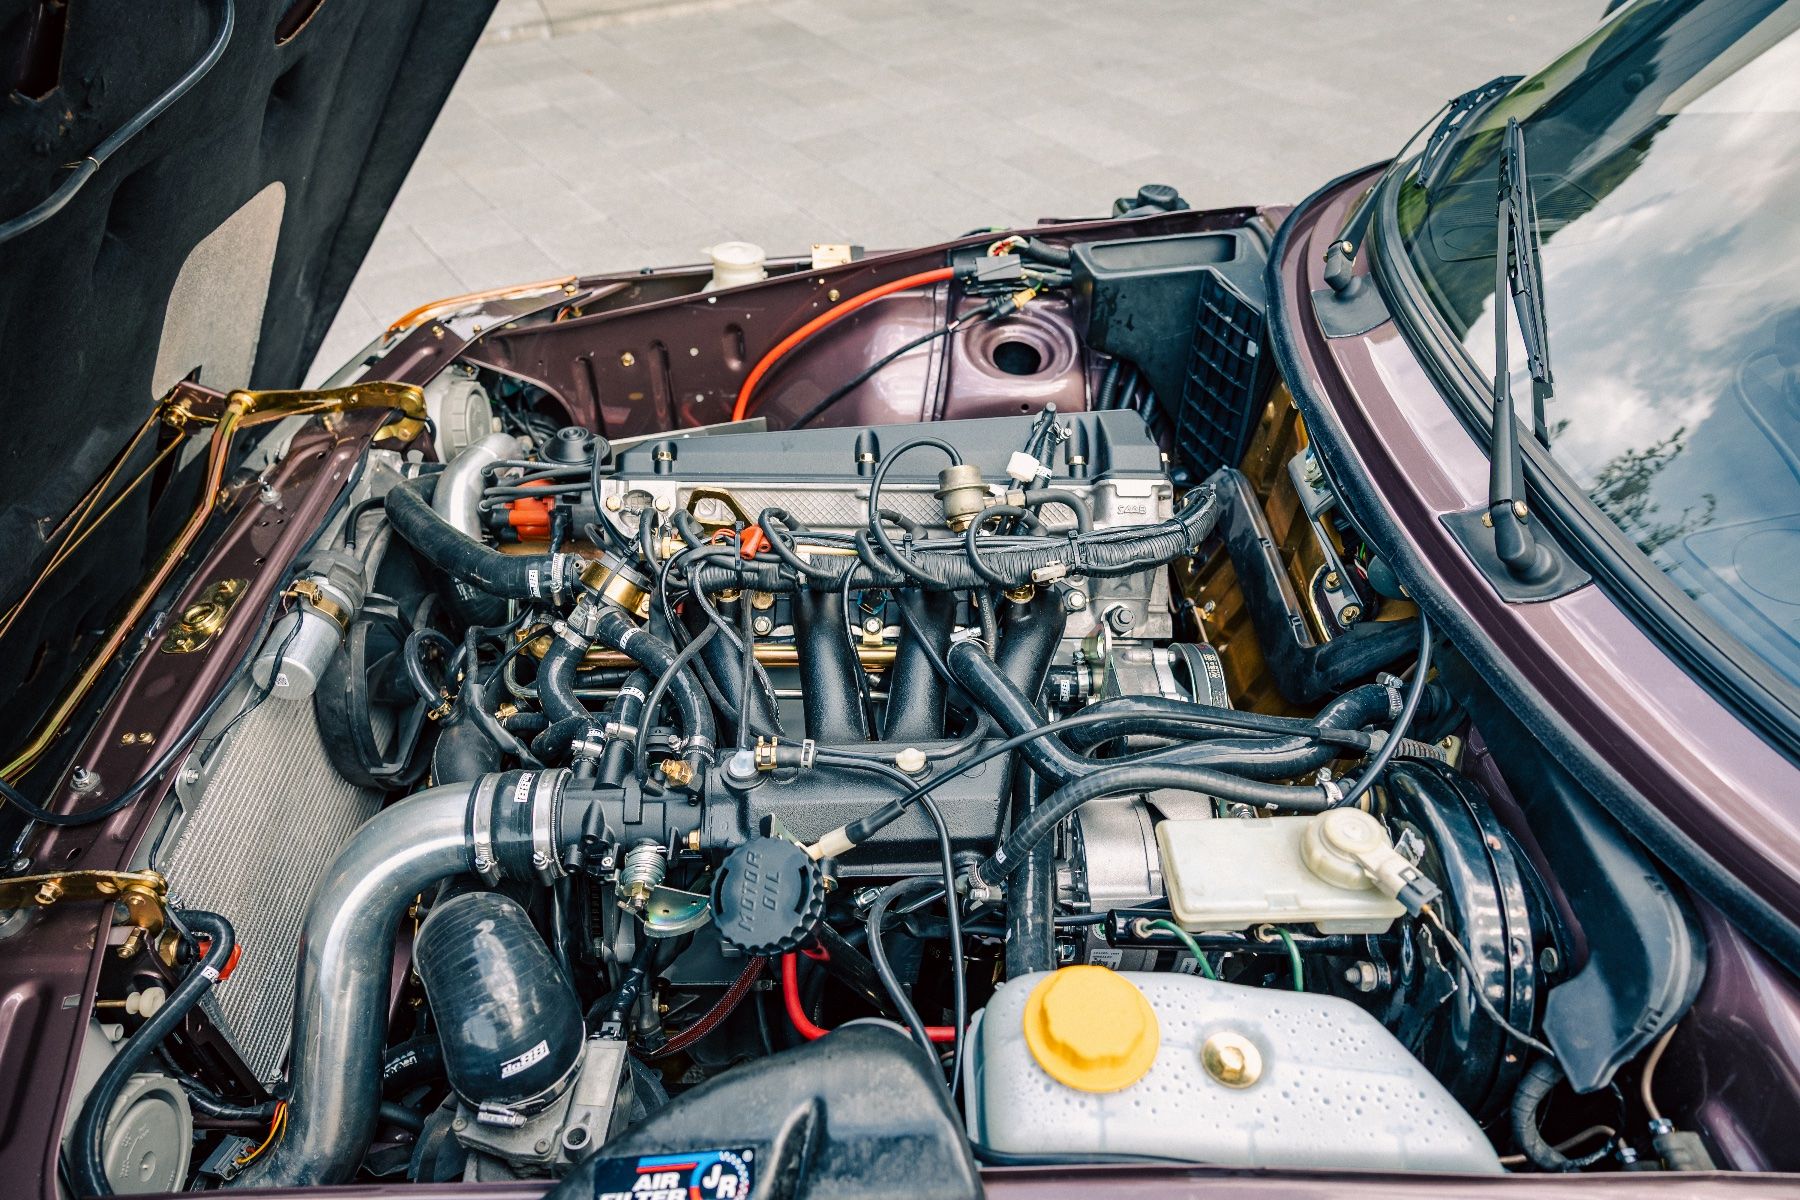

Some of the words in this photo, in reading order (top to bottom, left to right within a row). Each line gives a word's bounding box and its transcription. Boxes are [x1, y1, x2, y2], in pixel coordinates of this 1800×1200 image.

[1117, 505, 1147, 515] SAAB
[738, 850, 762, 933] MOTOR
[762, 871, 781, 912] OIL
[631, 1171, 681, 1192] AIR
